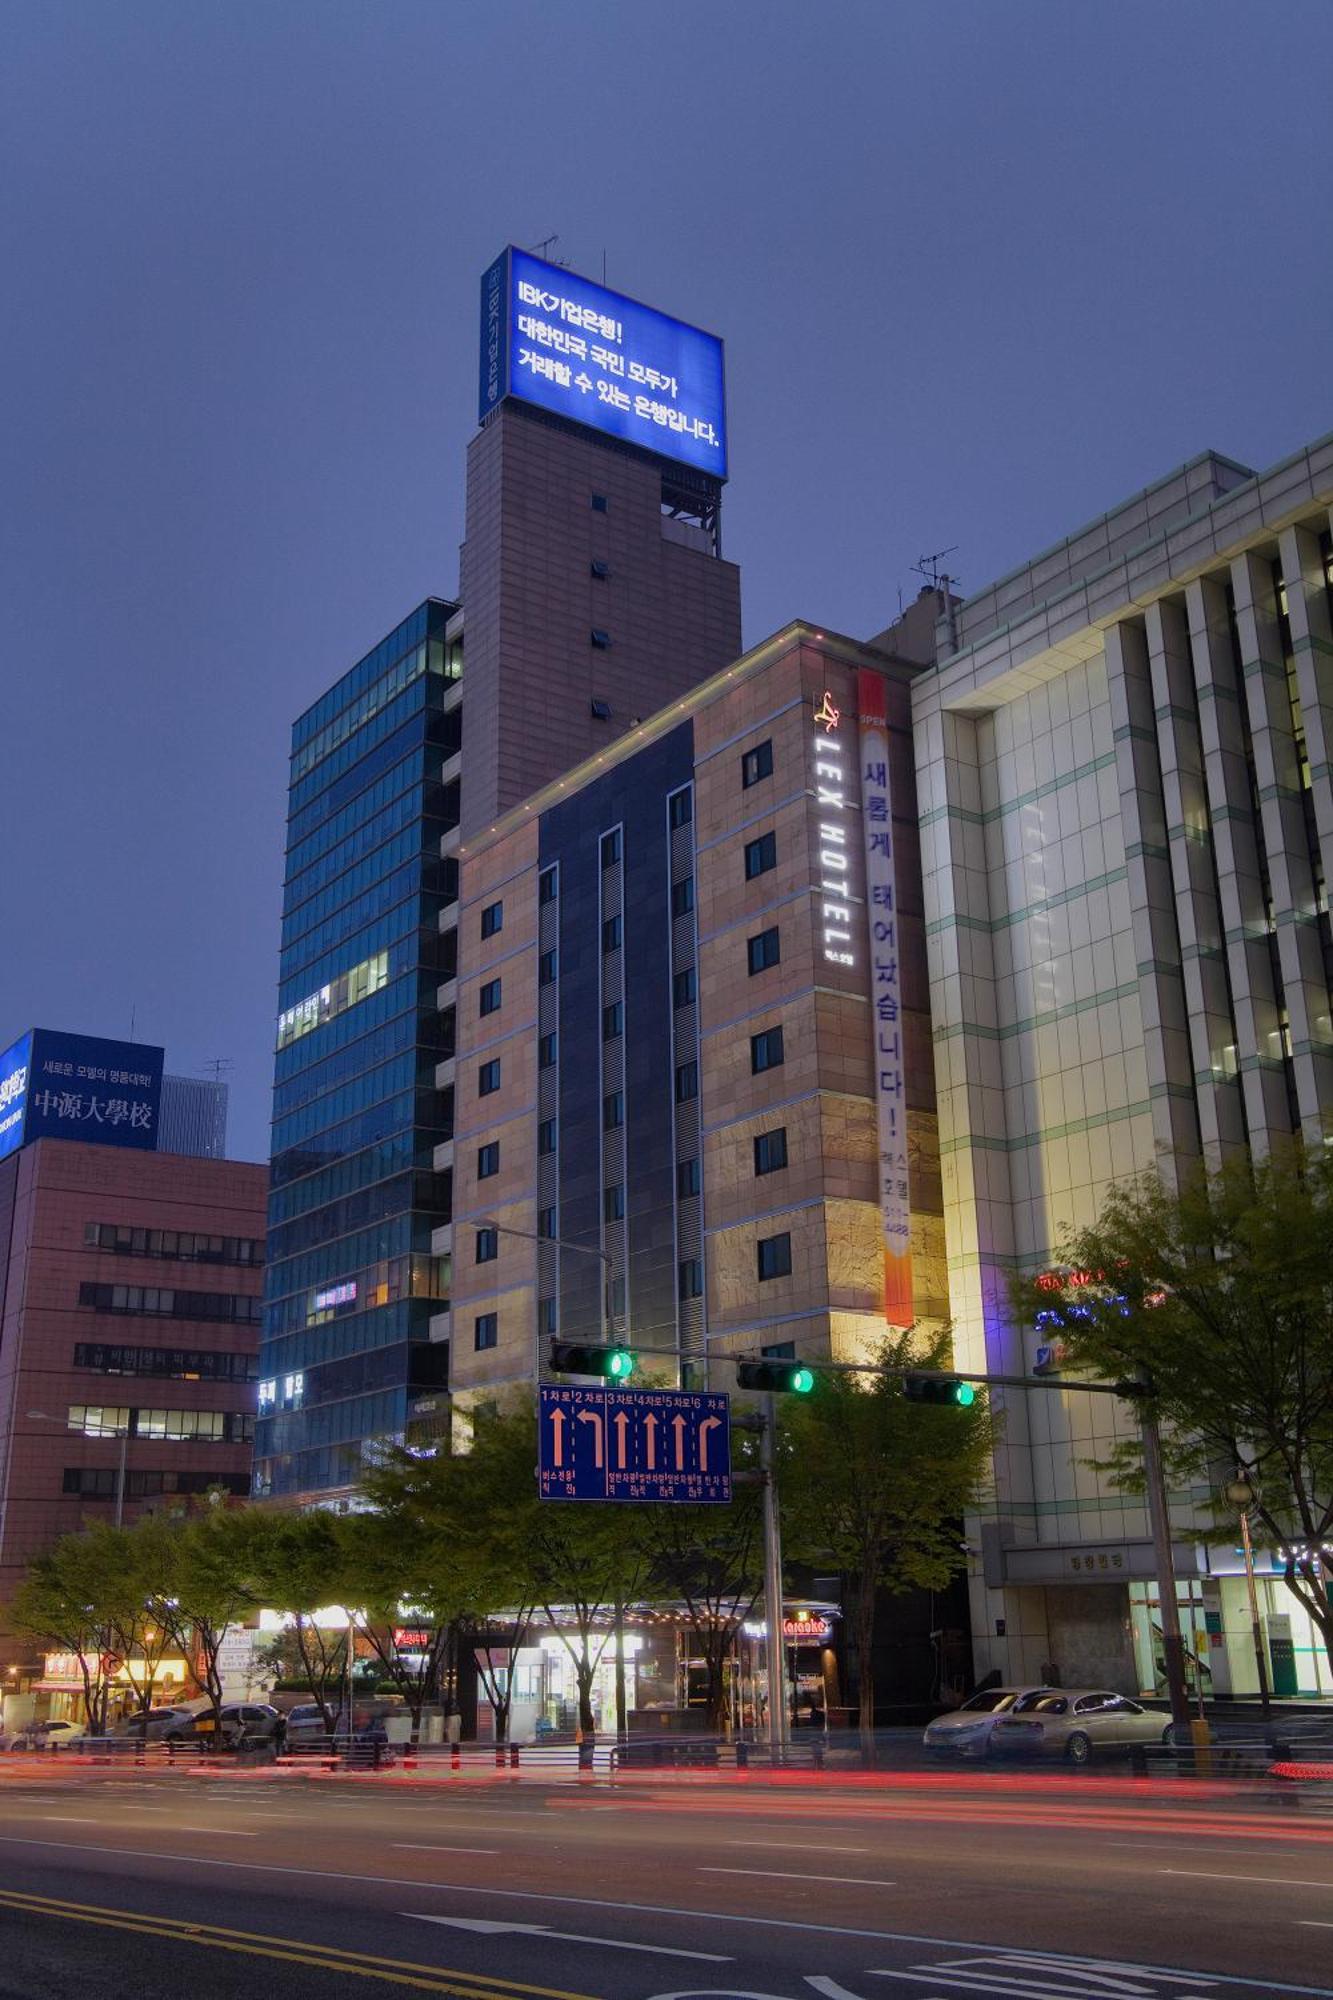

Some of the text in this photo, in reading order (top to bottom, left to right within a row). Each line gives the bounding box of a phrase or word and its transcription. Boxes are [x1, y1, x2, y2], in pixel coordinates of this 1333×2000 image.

[518, 281, 622, 344] IBK기업은행!
[518, 314, 678, 399] 대한민국 국민 모두가
[518, 348, 720, 447] 거래할 수 있는 은행입니다.
[815, 738, 850, 942] LEX HOTEL
[864, 762, 901, 1138] 새롭게 태어났습니다!
[34, 1089, 152, 1129] 中源大學校
[42, 1060, 152, 1088] 새로운 모델의 명품대학!
